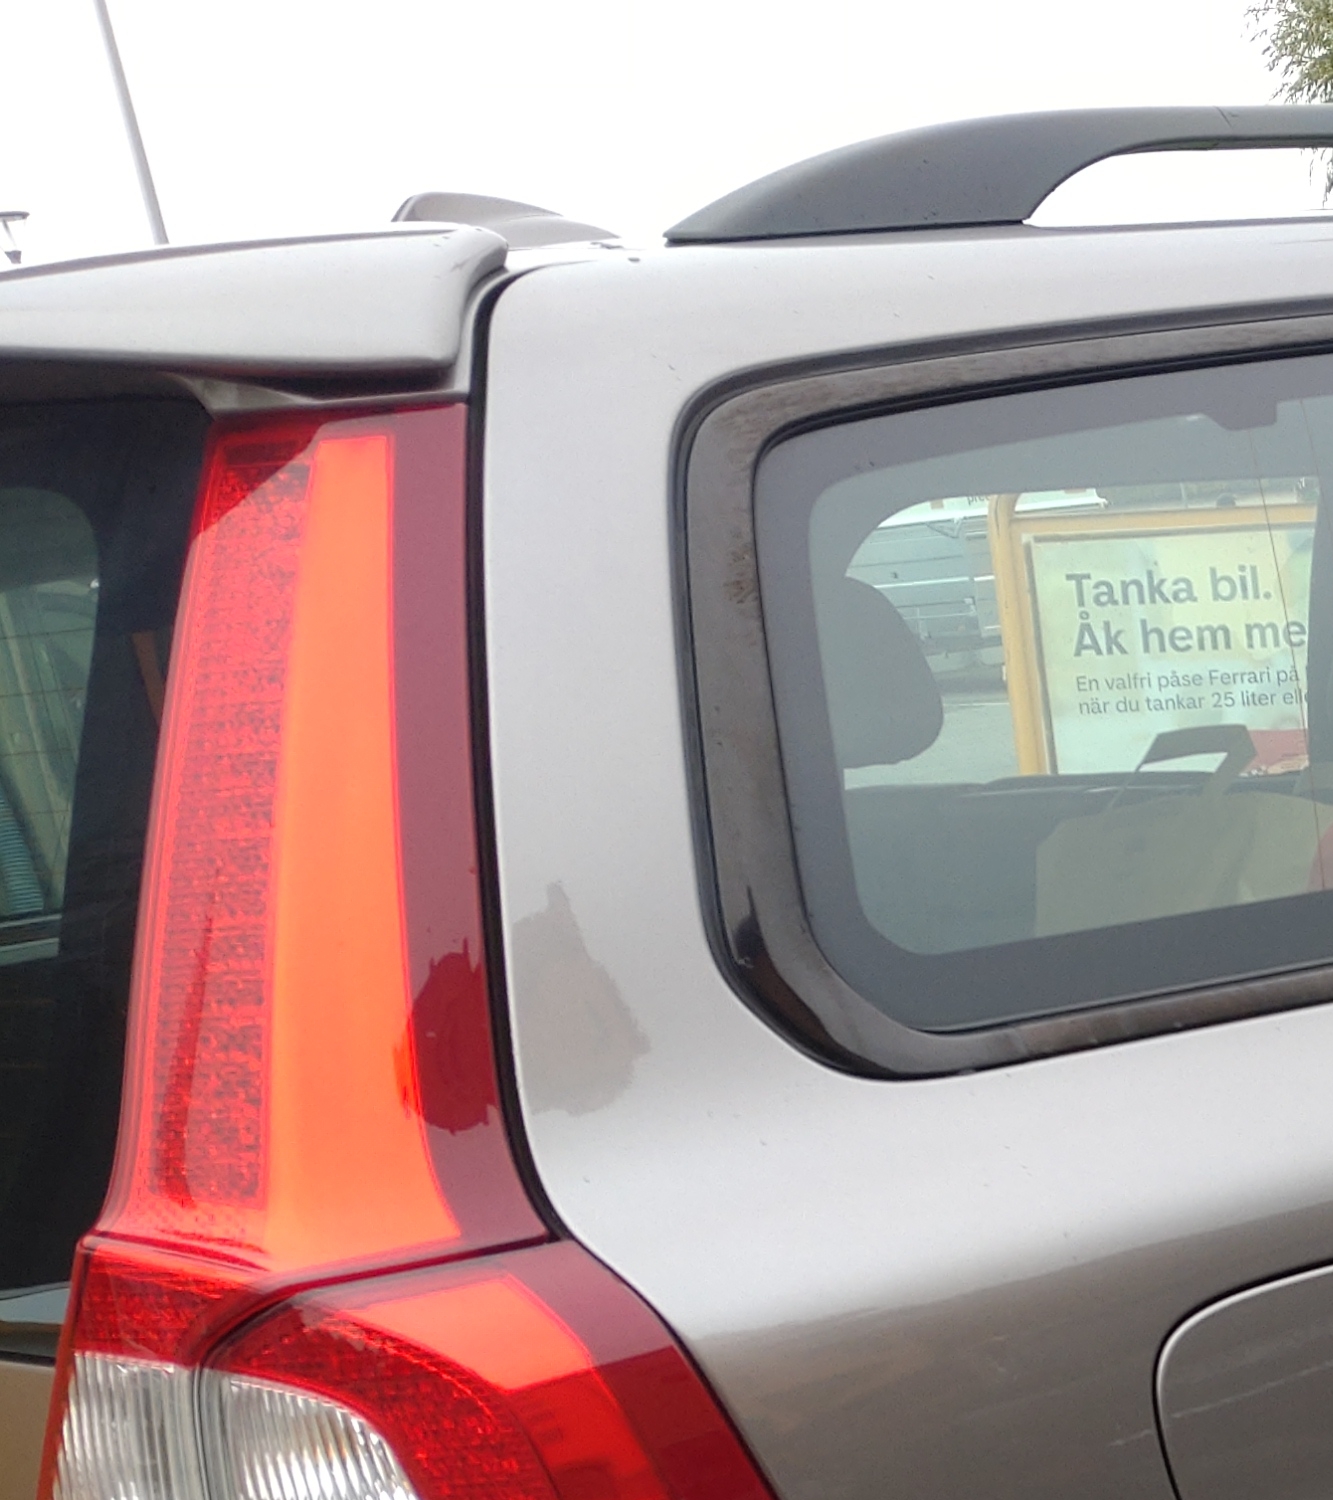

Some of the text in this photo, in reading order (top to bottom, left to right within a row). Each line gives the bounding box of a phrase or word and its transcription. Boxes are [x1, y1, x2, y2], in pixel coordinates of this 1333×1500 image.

[1065, 564, 1273, 608] Tanka bil.
[1073, 610, 1307, 657] Åk hem me
[1076, 665, 1300, 692] En valfri påse Ferrari på
[1079, 687, 1307, 715] när du tankar 25 liter ell
